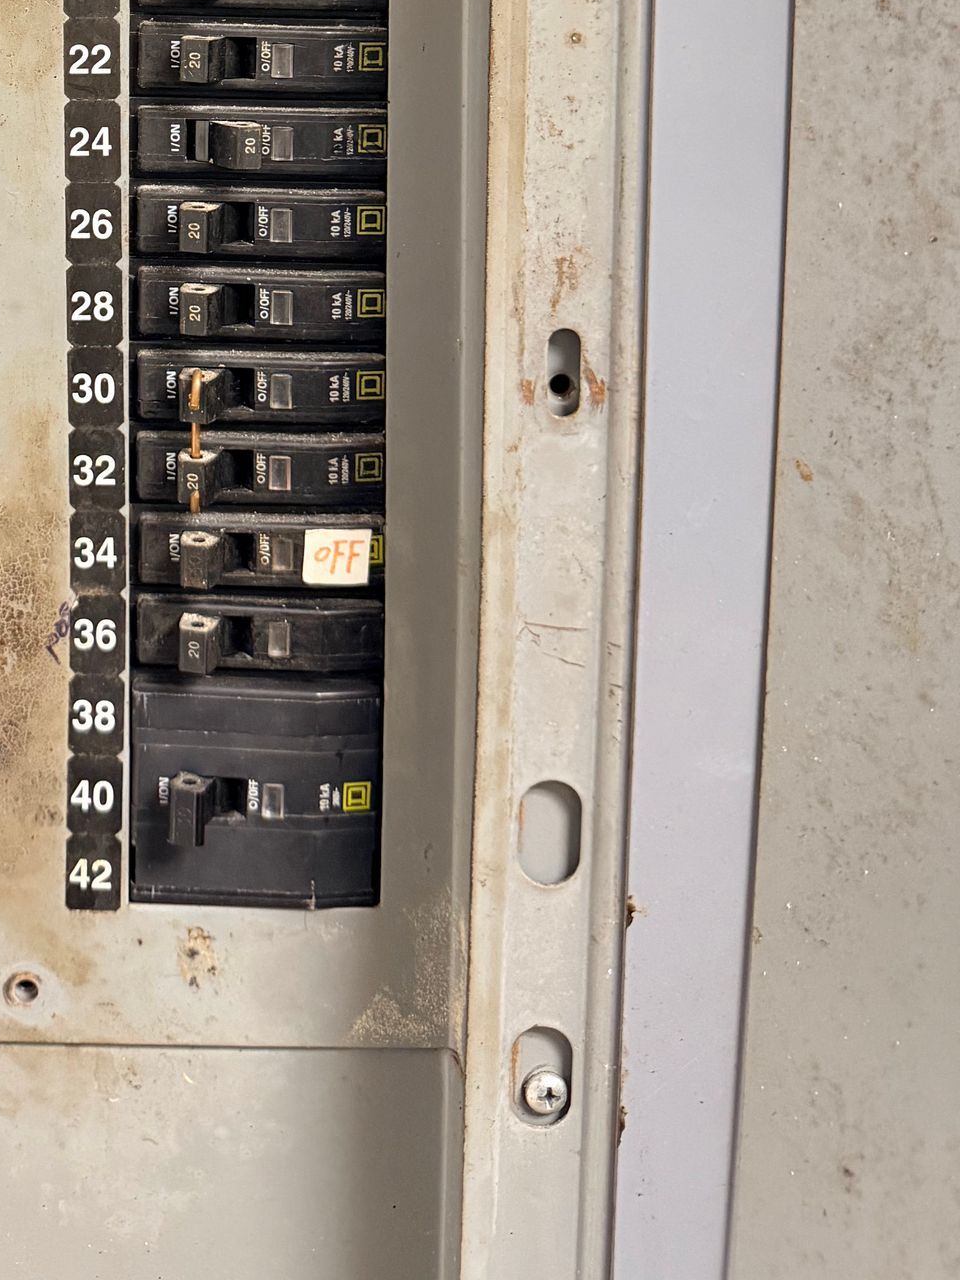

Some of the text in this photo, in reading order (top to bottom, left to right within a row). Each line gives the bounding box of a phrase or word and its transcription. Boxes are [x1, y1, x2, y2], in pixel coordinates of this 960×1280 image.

[69, 44, 111, 74] 22
[189, 52, 201, 69] 20
[70, 127, 112, 157] 24
[245, 138, 256, 154] 20
[70, 209, 113, 239] 26
[189, 223, 200, 240] 20
[71, 292, 113, 322] 28
[189, 305, 201, 322] 20
[72, 373, 116, 404] 30
[73, 455, 117, 486] 32
[187, 473, 199, 489] 20
[74, 537, 117, 568] 34
[74, 619, 117, 650] 36
[188, 641, 199, 659] 20
[71, 700, 116, 731] 38
[70, 780, 114, 811] 40
[69, 859, 112, 890] 42
